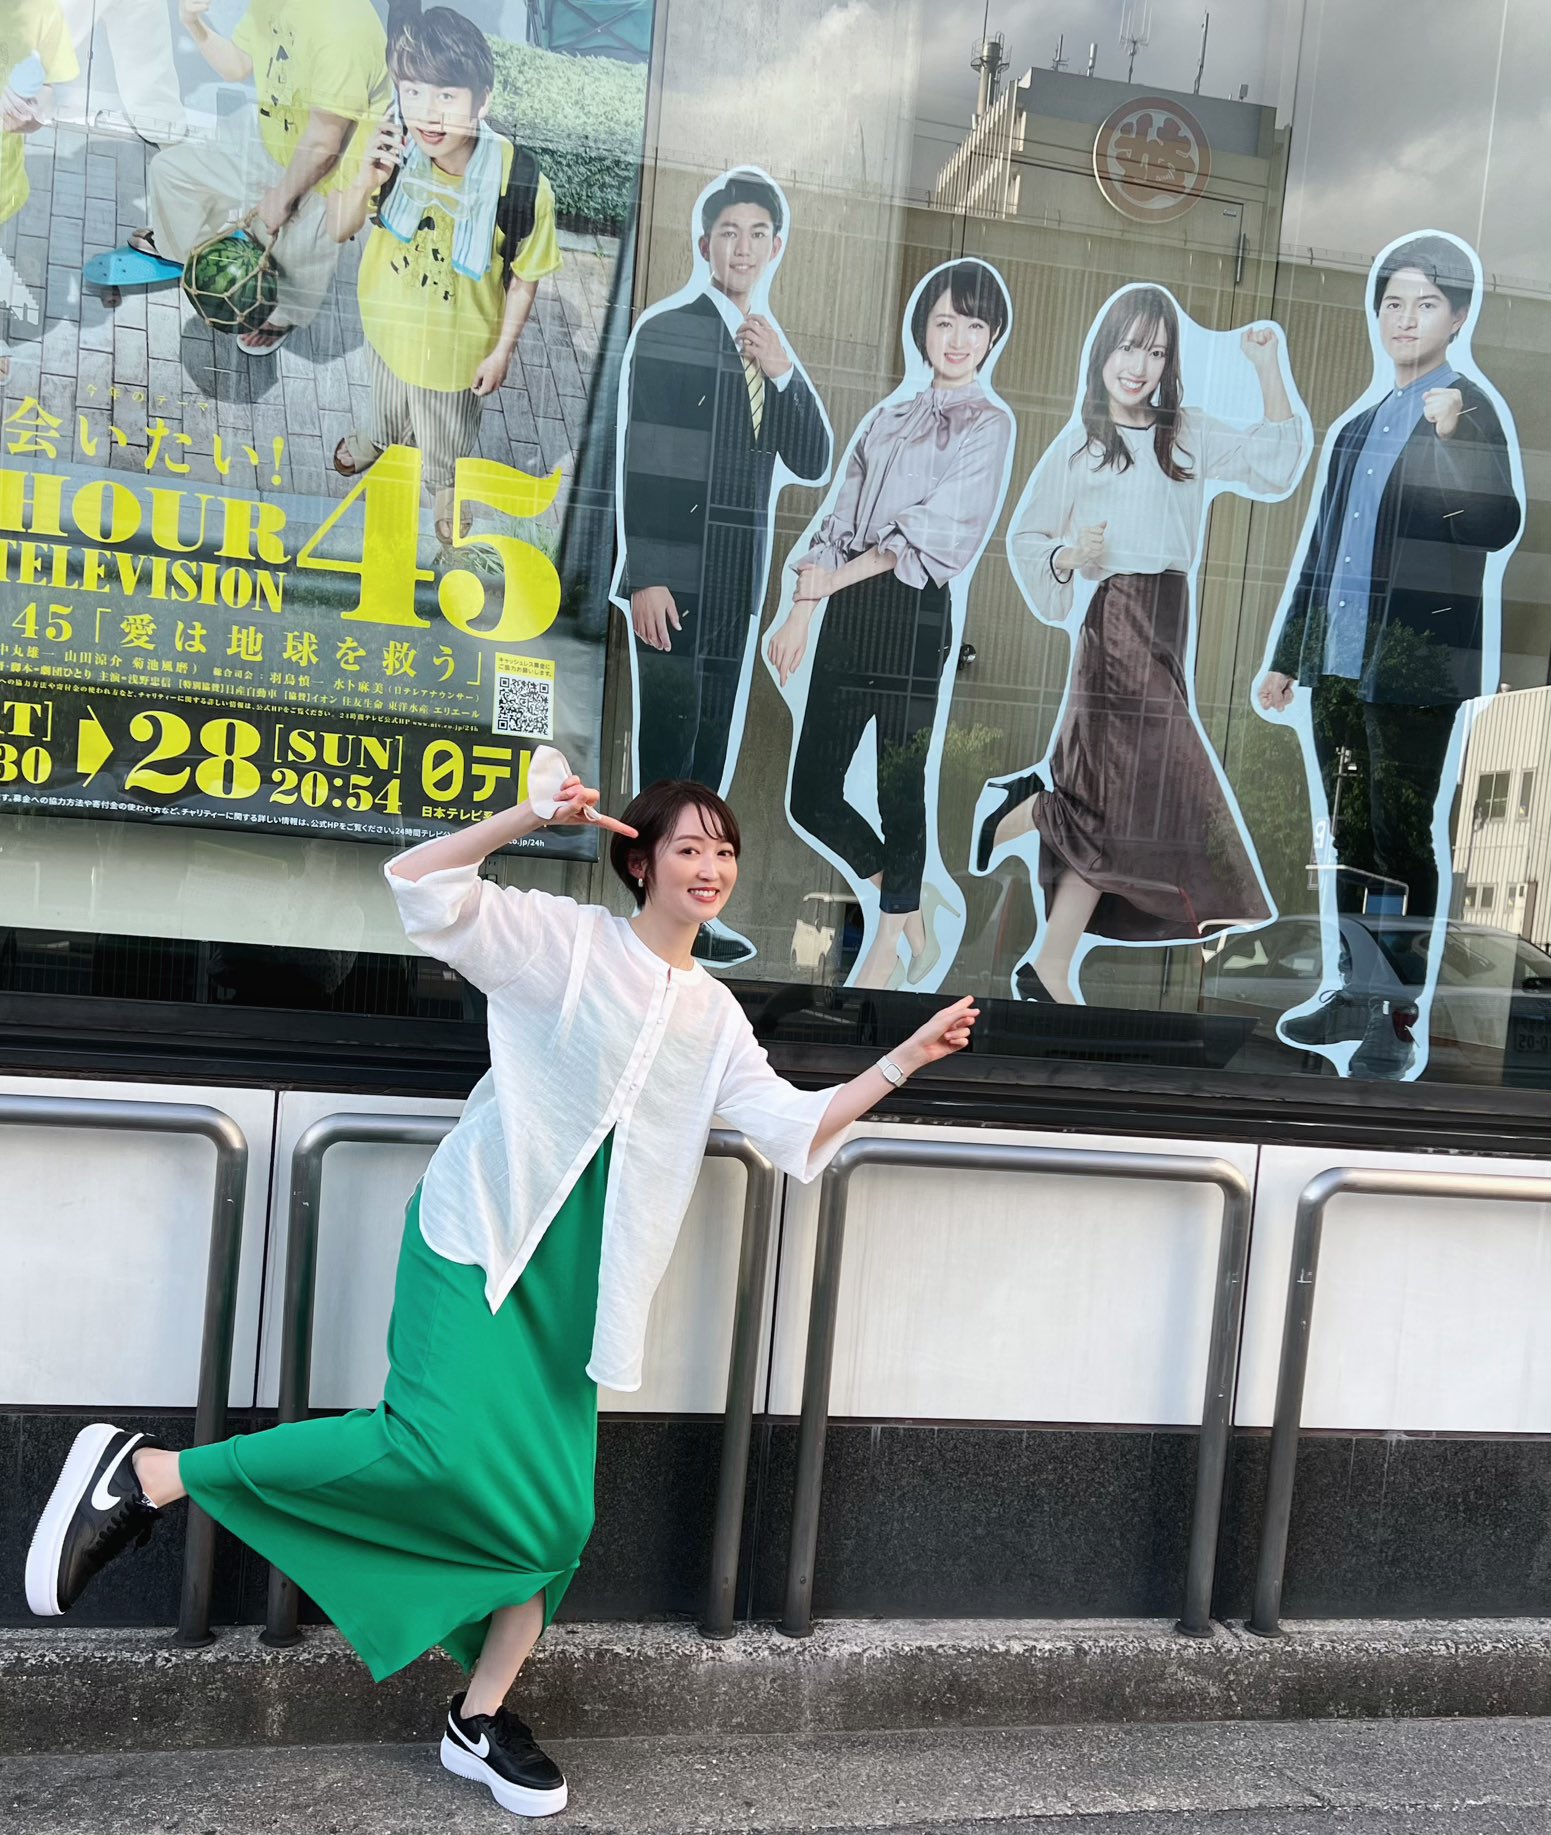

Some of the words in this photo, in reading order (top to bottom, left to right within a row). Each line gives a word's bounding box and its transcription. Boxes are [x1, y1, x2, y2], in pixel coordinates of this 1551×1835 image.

[0, 469, 292, 564] HOUR
[296, 443, 562, 642] 45
[124, 710, 262, 799] 28
[269, 767, 403, 815] 20:54
[274, 724, 403, 774] [SUN]
